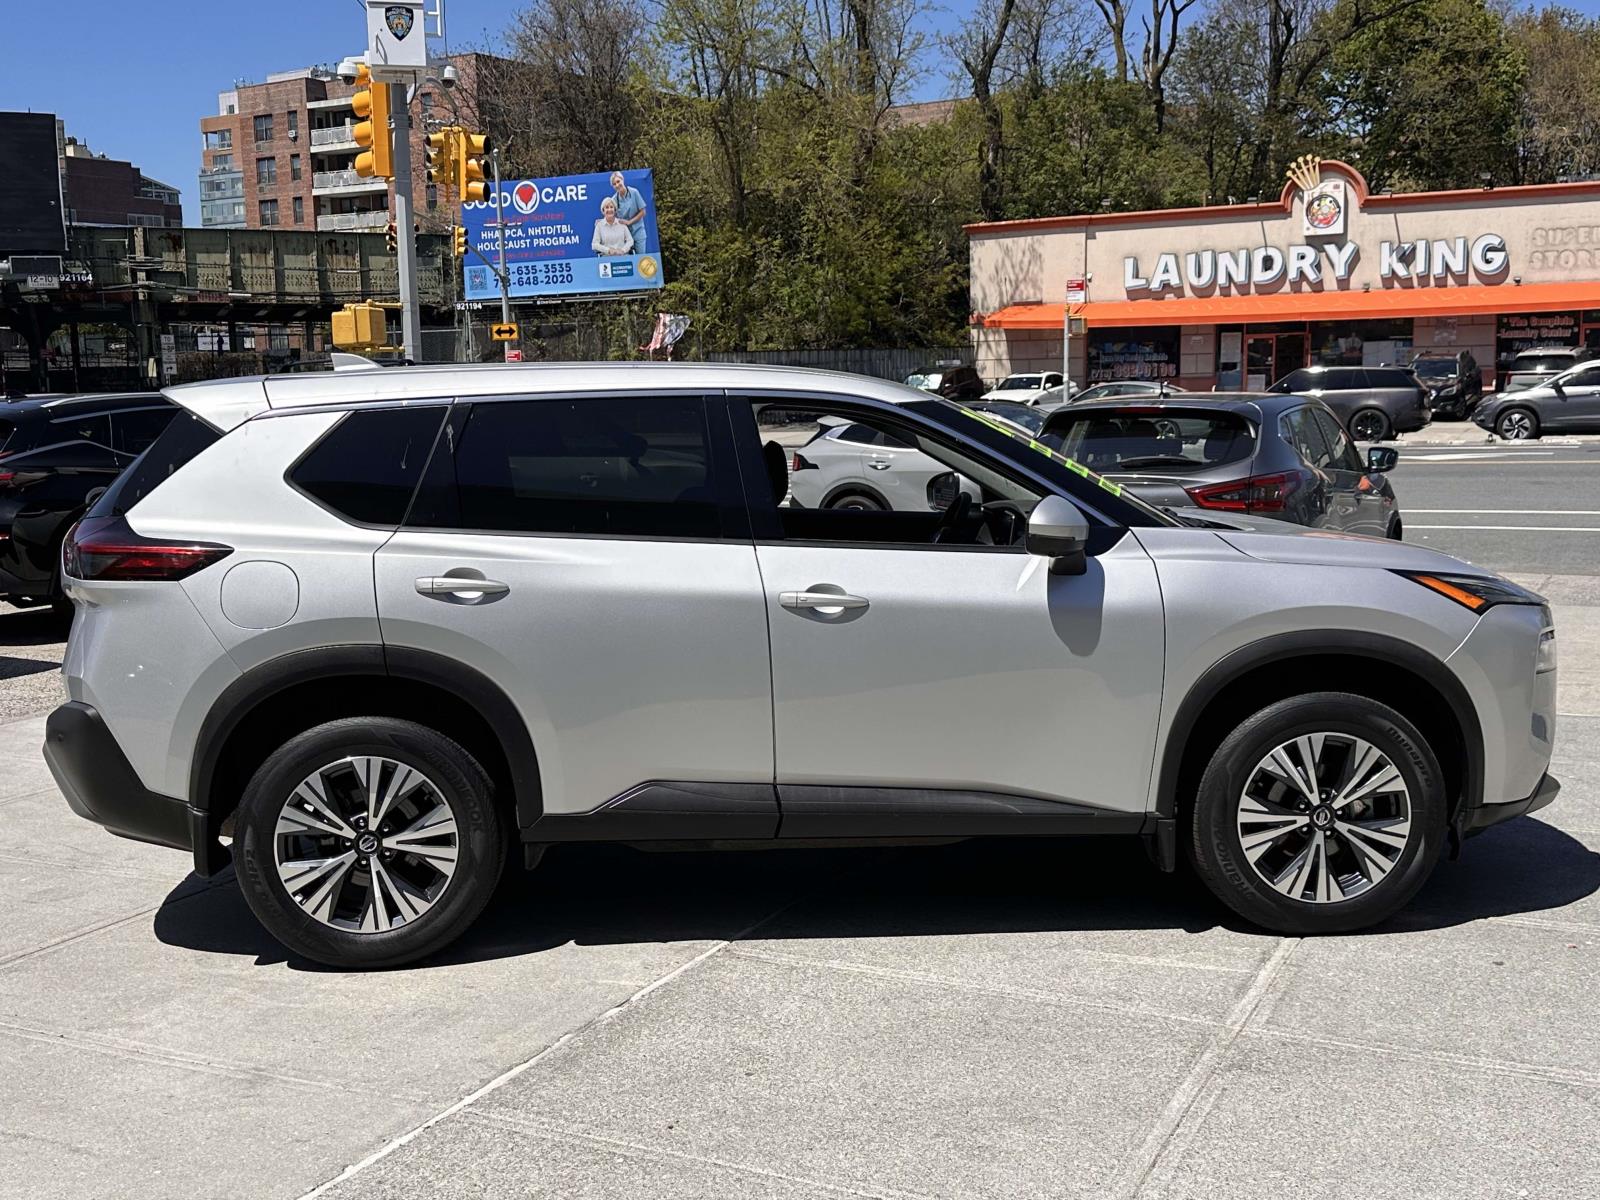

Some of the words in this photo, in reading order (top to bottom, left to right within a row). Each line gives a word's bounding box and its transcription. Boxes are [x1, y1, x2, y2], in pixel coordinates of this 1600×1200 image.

[541, 184, 588, 203] CARE
[505, 228, 526, 238] PCA,
[528, 224, 574, 236] NHTD/TBI,
[534, 235, 579, 248] PROGRAM
[1123, 239, 1360, 291] LAUNDRY
[1379, 232, 1508, 279] KING
[494, 262, 572, 277] 8-635-3535
[493, 274, 574, 288] 7-648-2020
[456, 302, 483, 310] 921194
[1529, 315, 1574, 327] Complete
